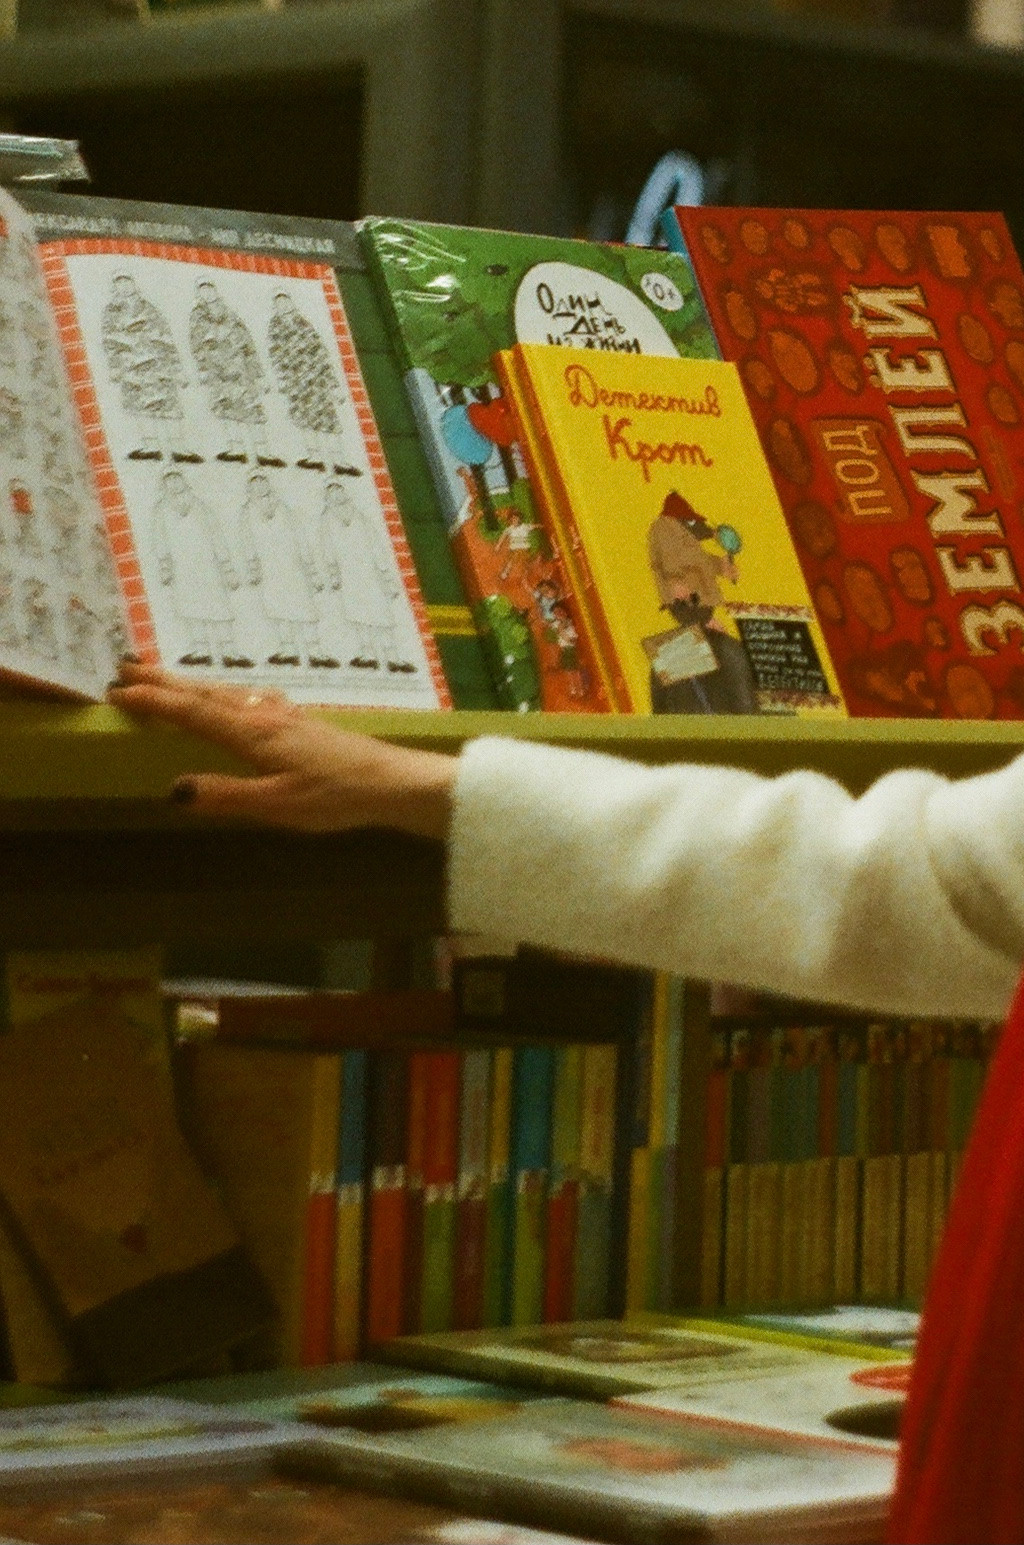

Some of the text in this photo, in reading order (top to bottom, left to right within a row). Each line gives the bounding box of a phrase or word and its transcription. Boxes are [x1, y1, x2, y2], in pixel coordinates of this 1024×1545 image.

[564, 364, 722, 419] Детектив
[602, 414, 713, 483] Крот
[822, 424, 893, 517] ПОД
